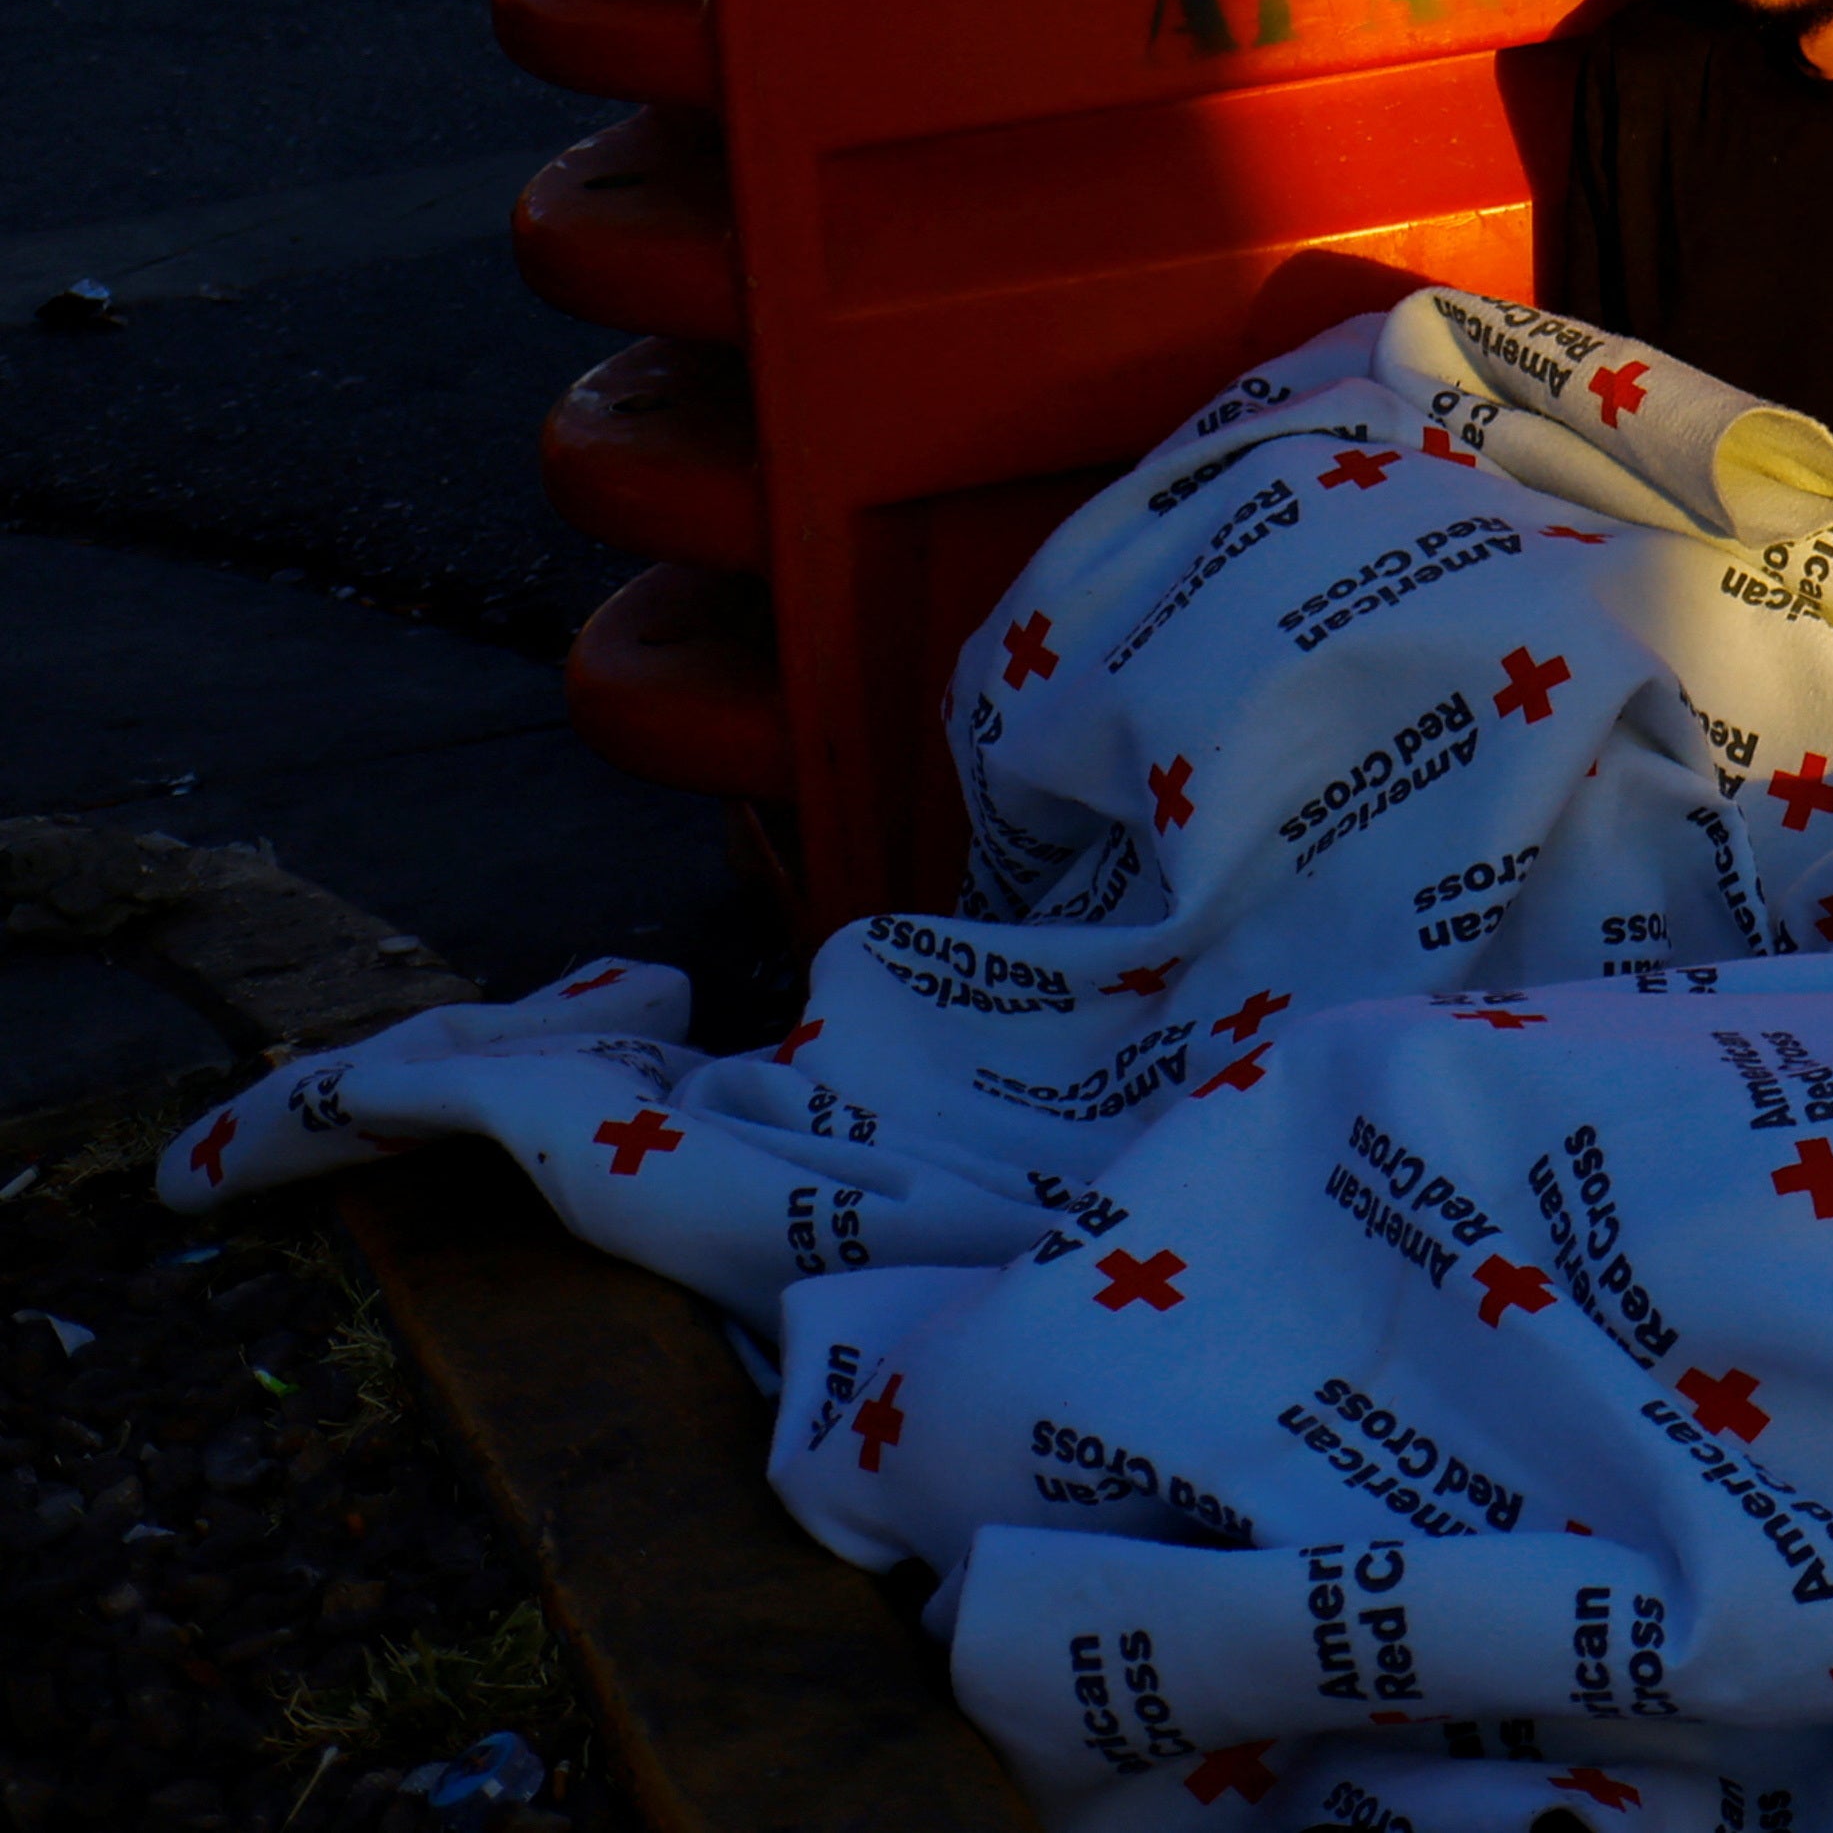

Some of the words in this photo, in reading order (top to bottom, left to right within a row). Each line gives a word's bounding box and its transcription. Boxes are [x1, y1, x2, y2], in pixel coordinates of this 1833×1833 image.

[1434, 297, 1572, 399] American
[1537, 321, 1605, 362] Red
[1211, 479, 1293, 551] Red
[1278, 548, 1413, 634] Cross
[1294, 533, 1523, 652] American
[1391, 692, 1474, 763] Red
[1279, 750, 1394, 843] Cross
[1295, 727, 1480, 877] American
[865, 916, 977, 979] Cross
[986, 955, 1073, 997] Red
[1116, 1019, 1197, 1077] Red
[1348, 1115, 1428, 1200] Cross
[1564, 1125, 1620, 1260] Cross
[1325, 1164, 1459, 1290] American
[1418, 1172, 1501, 1247] Red
[1600, 1264, 1680, 1360] Red
[1315, 1378, 1441, 1480] Cross
[1434, 1452, 1524, 1532] Red
[1119, 1630, 1197, 1762] Cross
[1358, 1606, 1423, 1702] Red
